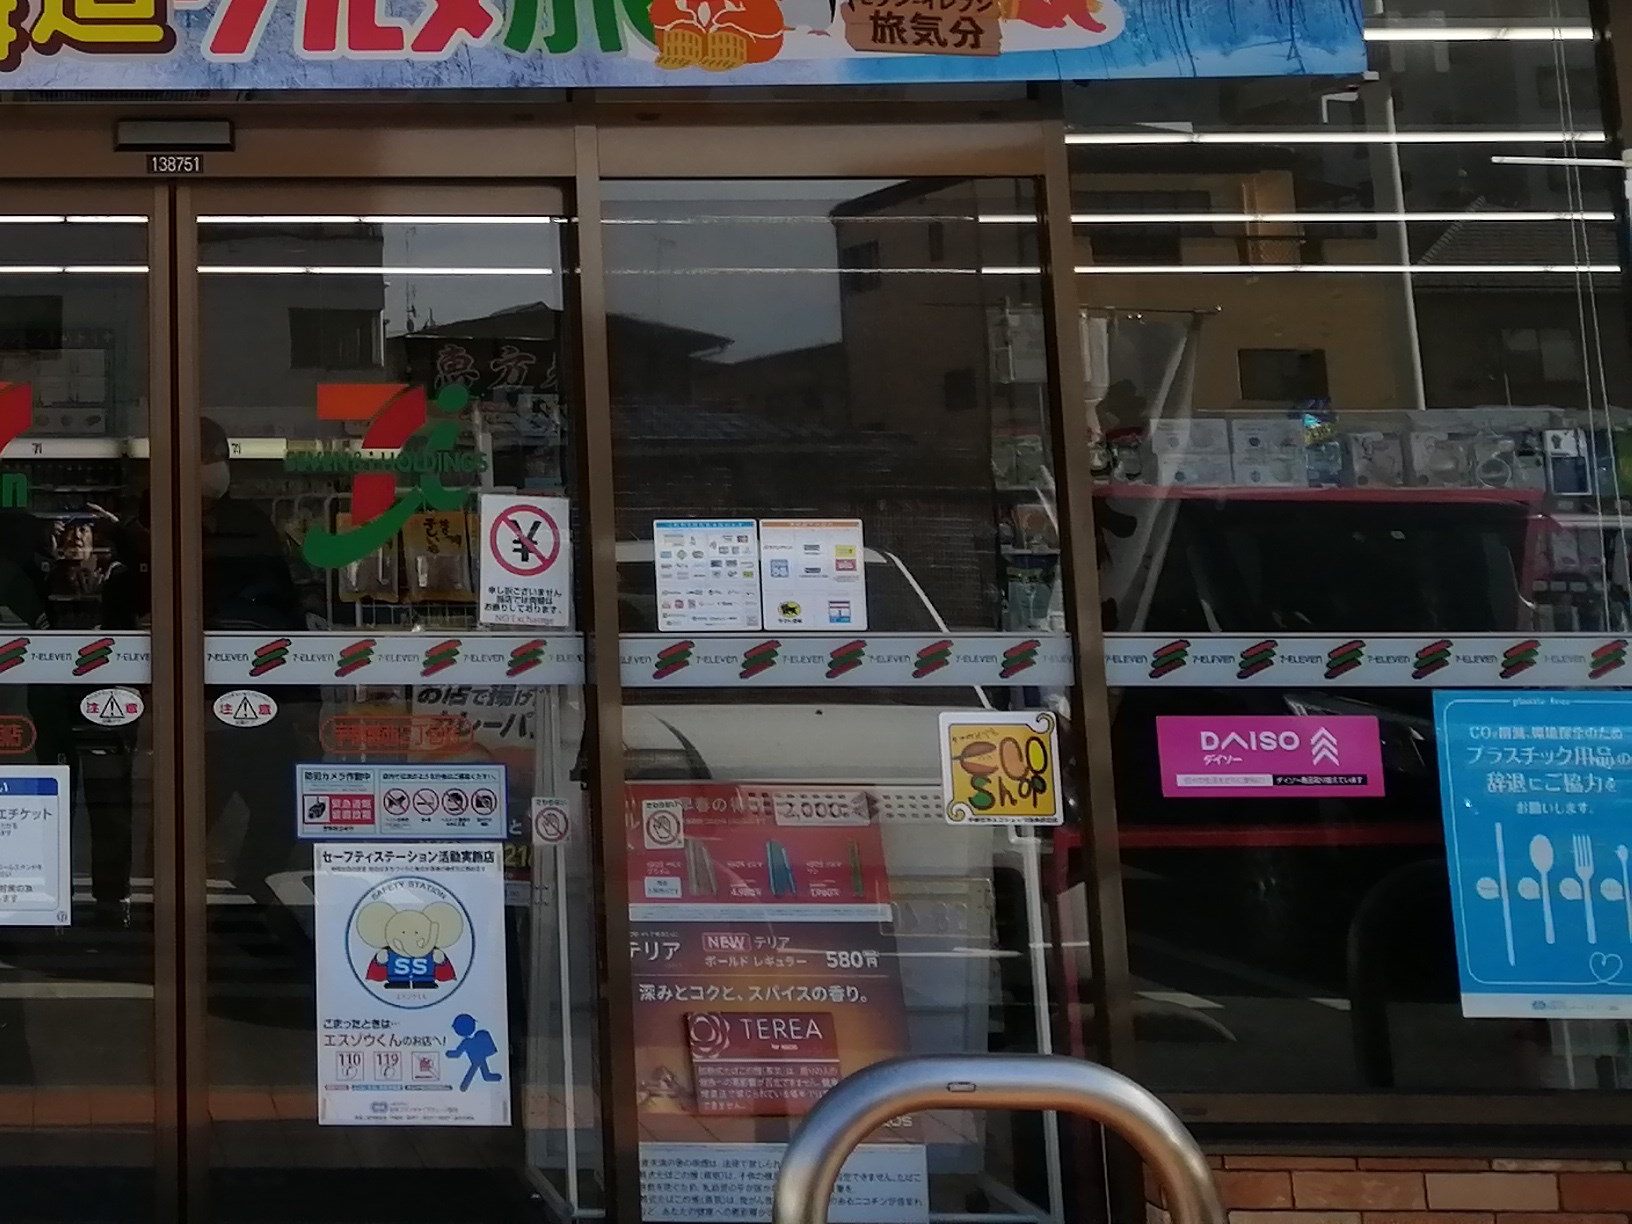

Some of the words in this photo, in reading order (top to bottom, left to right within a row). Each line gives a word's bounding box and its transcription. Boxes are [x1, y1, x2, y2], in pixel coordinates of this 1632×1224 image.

[870, 11, 987, 50] 旅気分
[152, 156, 200, 172] 138751
[1200, 731, 1300, 751] DAISO
[1203, 754, 1243, 766] ダイソー
[1486, 772, 1617, 794] 辞退にご協力を
[1516, 801, 1595, 816] お願いします。
[322, 850, 495, 864] セーフティステーション活動実施店
[371, 881, 405, 900] SAFETY
[407, 881, 448, 900] STATION
[630, 941, 681, 961] テリア
[707, 936, 746, 950] NEW
[755, 936, 791, 950] テリア
[393, 957, 429, 976] SS
[705, 957, 749, 969] ボールド
[753, 957, 808, 969] レギュラー
[639, 984, 869, 1004] 深みとコクと、スパイスの香り。
[739, 1018, 824, 1040] TEREA
[324, 1032, 447, 1048] エスゾウくんのお店へ!
[339, 1053, 361, 1066] 110
[376, 1053, 399, 1066] 119
